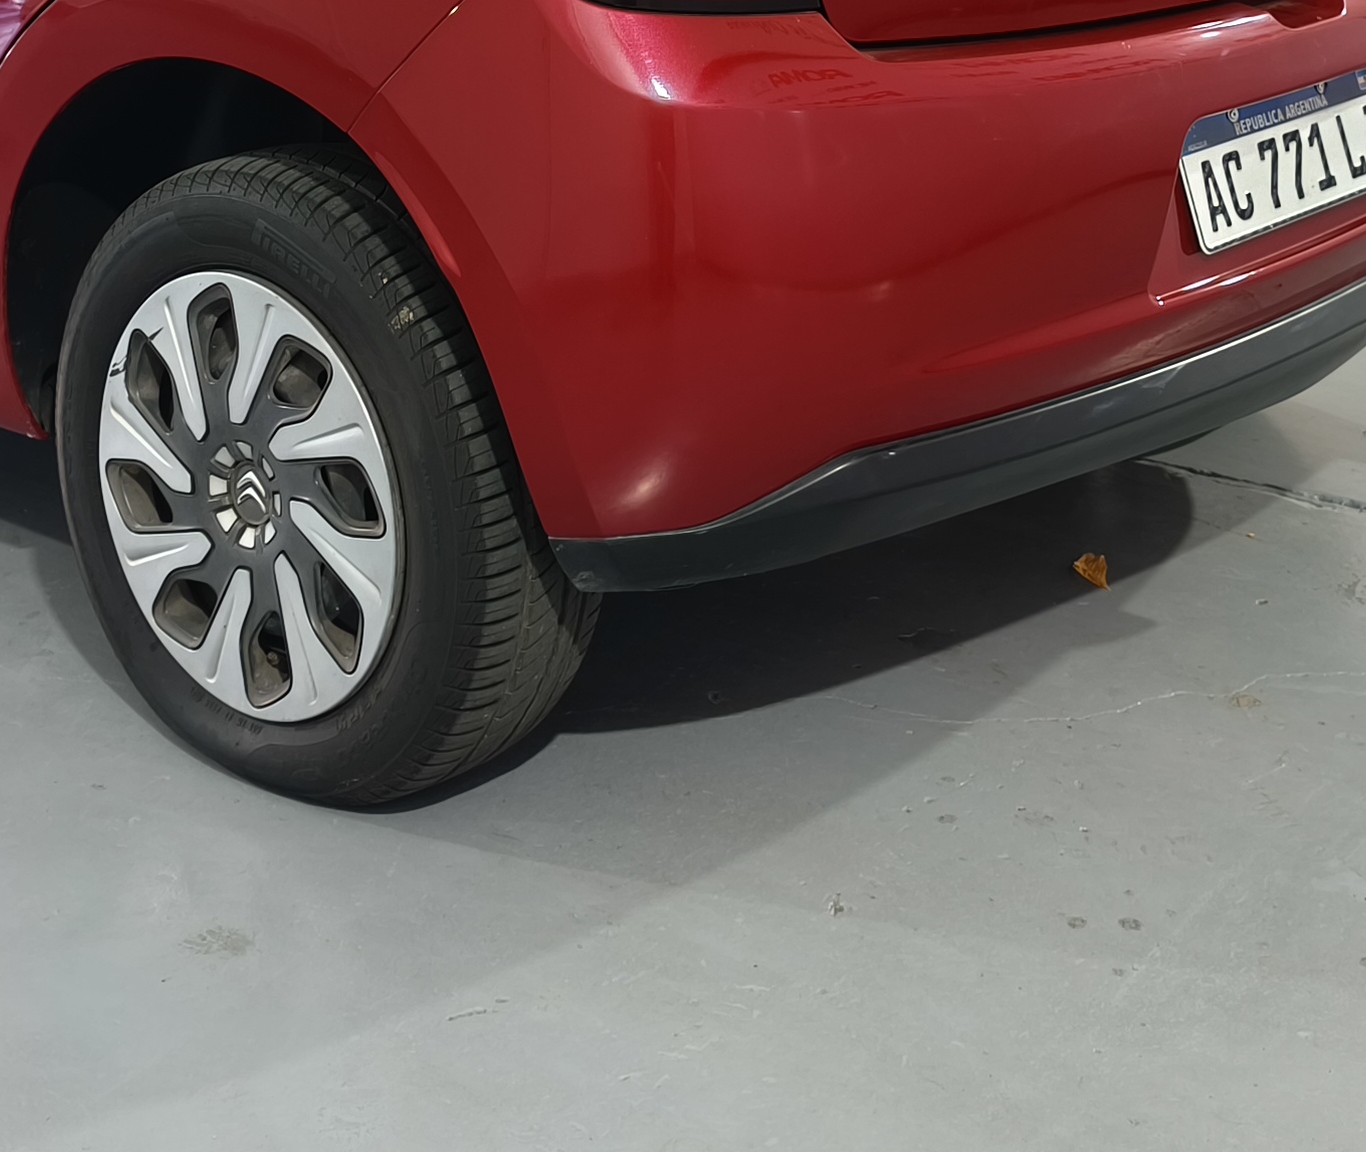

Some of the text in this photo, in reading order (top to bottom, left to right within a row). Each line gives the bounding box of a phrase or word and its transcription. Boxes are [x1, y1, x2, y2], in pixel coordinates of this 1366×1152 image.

[1234, 94, 1329, 136] REPUBLICA ARGENTINA
[1200, 150, 1255, 233] AC
[1256, 122, 1338, 209] 771
